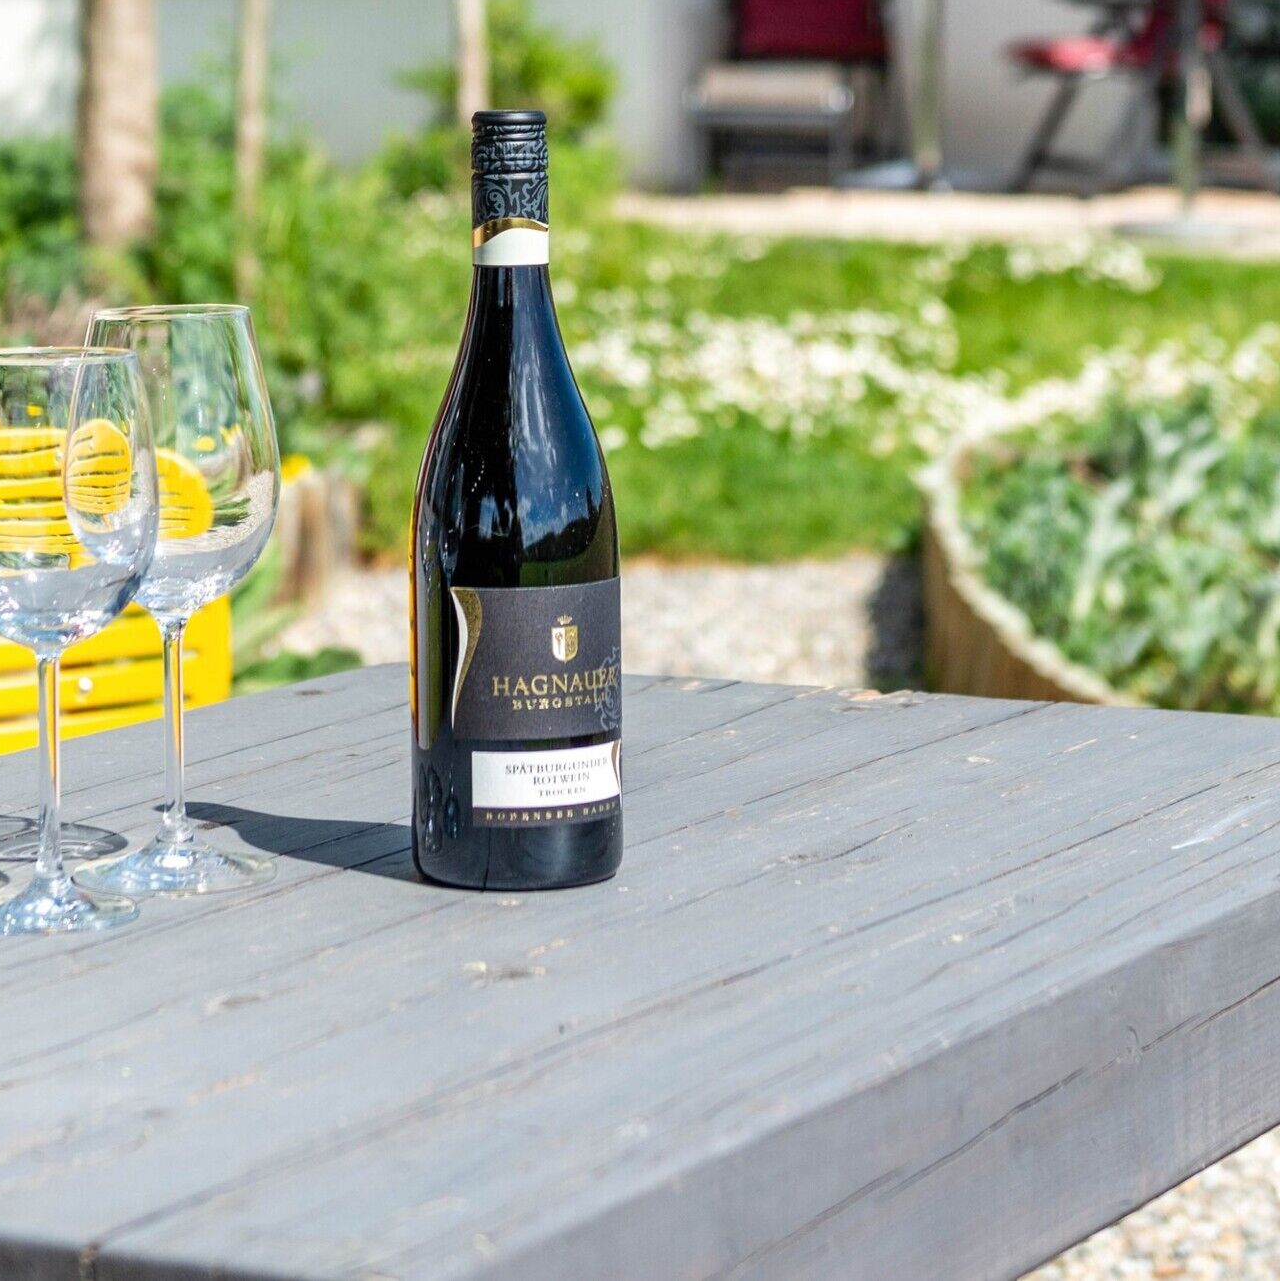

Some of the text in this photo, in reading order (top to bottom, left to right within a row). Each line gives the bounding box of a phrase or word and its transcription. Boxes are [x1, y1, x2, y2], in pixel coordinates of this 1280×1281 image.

[492, 666, 617, 696] HAGNAUER
[505, 756, 608, 774] SPÄTBURGUNDER
[533, 772, 590, 785] ROTWEIN
[538, 787, 586, 797] TROCKEN
[486, 809, 574, 821] BODENSEE
